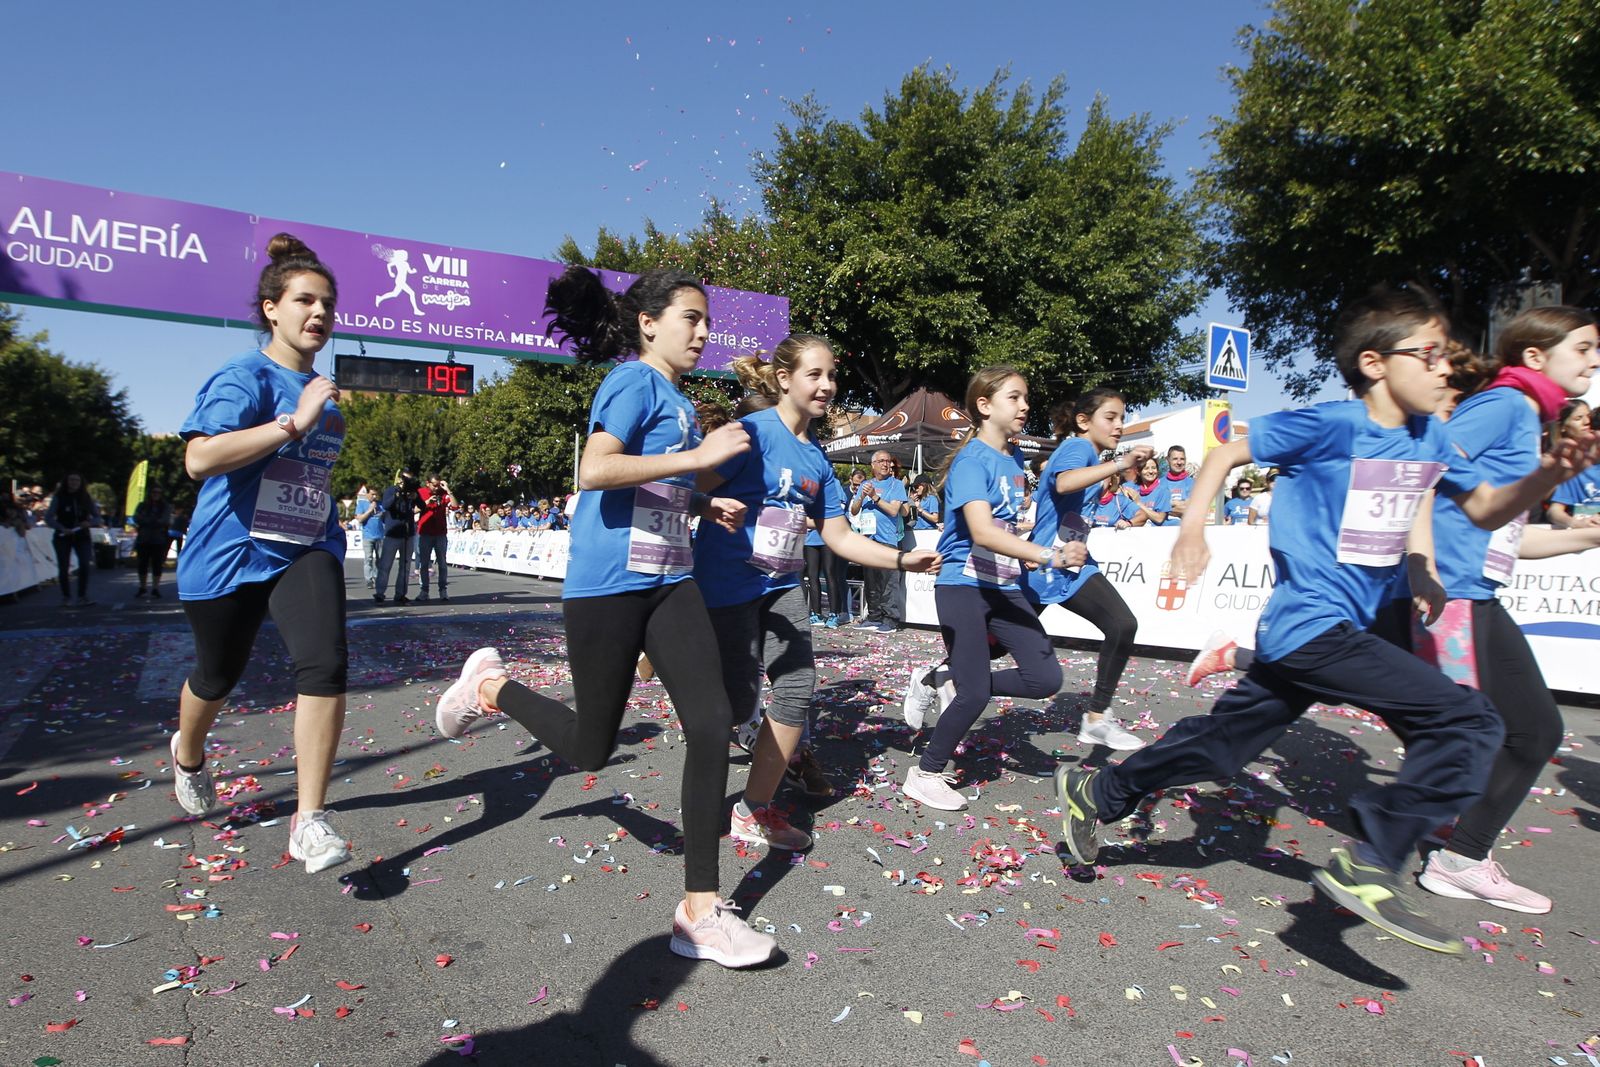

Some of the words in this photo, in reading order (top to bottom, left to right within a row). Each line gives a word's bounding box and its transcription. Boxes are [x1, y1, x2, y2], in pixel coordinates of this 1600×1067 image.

[8, 206, 208, 263] ALMERÍA
[7, 241, 114, 273] CIUDAD
[422, 253, 468, 277] VIII
[422, 275, 470, 289] CARRERA
[421, 290, 471, 311] mujer
[401, 319, 423, 334] ES
[428, 323, 506, 343] NUESTRA
[510, 332, 560, 349] META.
[1096, 556, 1145, 584] RÍA
[1534, 597, 1600, 617] ALM
